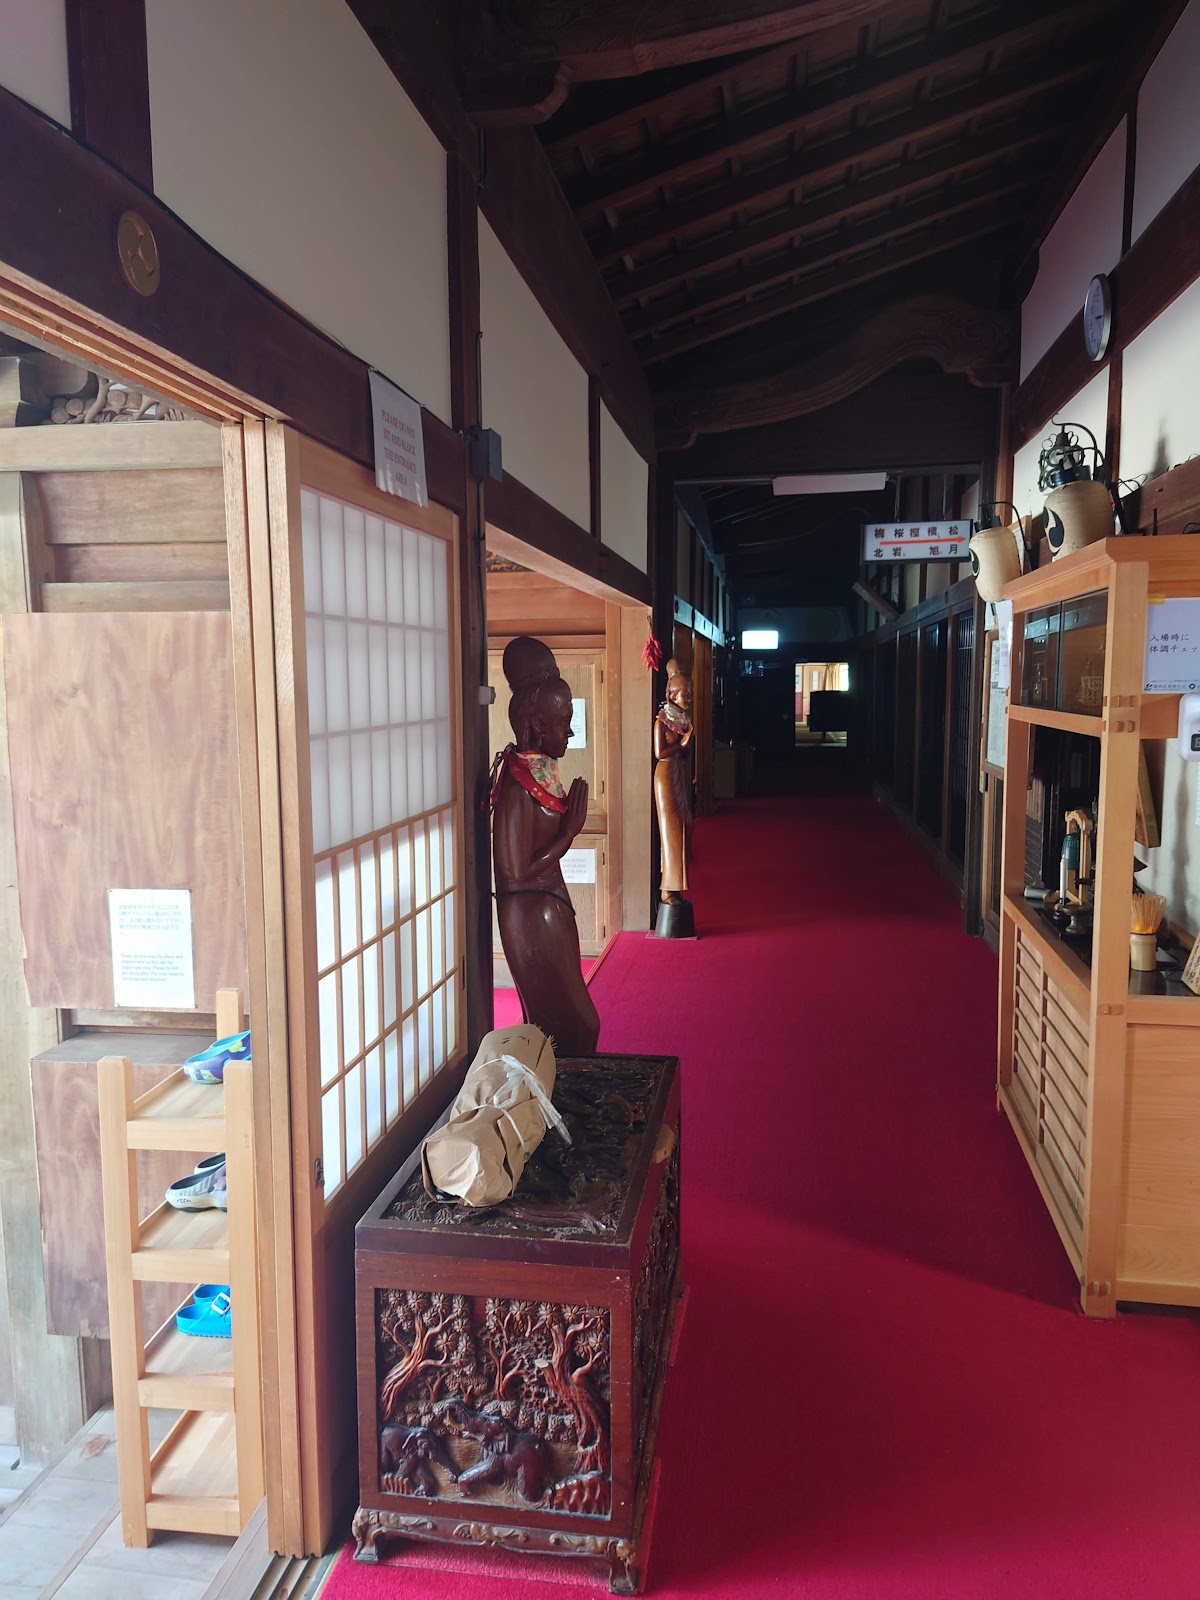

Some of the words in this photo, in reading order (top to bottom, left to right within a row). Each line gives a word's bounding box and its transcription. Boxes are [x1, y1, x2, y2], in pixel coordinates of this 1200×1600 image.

[381, 409, 399, 429] PLEASE
[399, 420, 407, 433] DO
[407, 426, 416, 440] NOT
[391, 433, 401, 448] AND
[402, 439, 416, 457] BLOCK
[384, 447, 394, 462] THE
[395, 453, 417, 474] ENTRANCE
[395, 472, 408, 486] AREA
[1150, 633, 1190, 642] 入場時に
